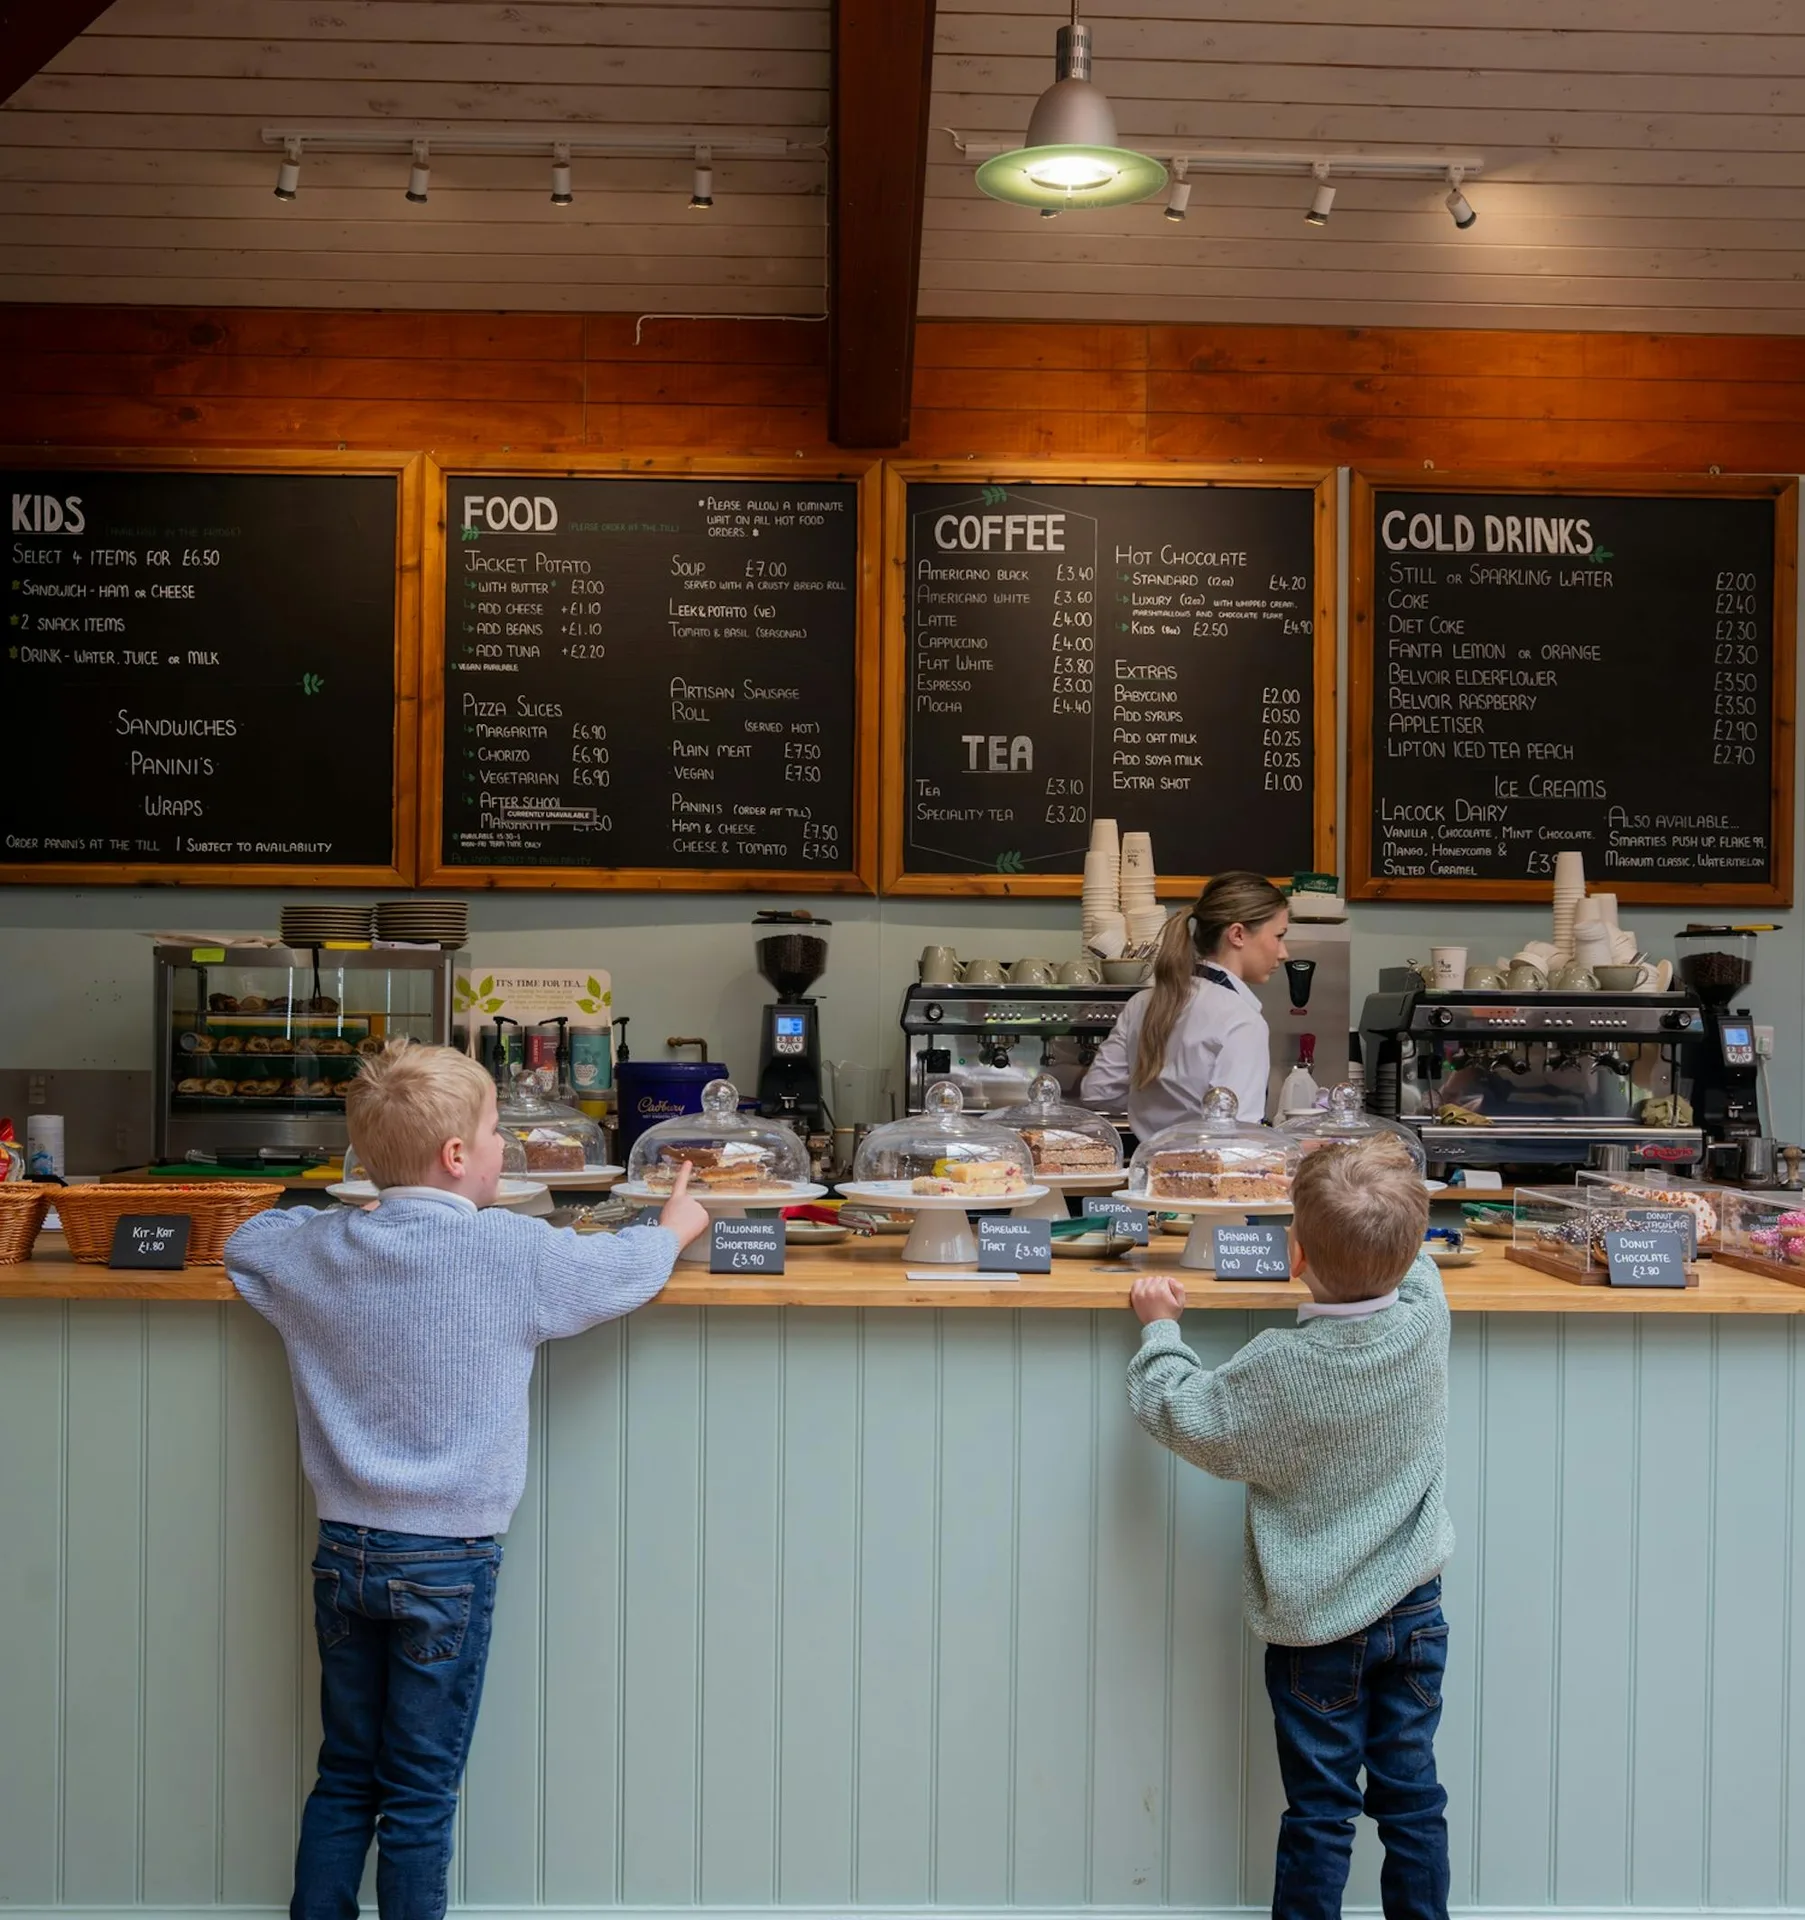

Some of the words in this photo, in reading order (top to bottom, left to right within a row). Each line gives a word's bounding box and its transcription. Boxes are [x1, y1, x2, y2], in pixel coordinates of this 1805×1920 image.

[12, 494, 85, 532] KIDS
[464, 496, 557, 531] FOOD
[707, 515, 730, 524] WAIT
[735, 515, 750, 525] ON
[754, 516, 770, 525] ALL
[775, 516, 795, 525] HOT
[799, 516, 824, 525] FOOD
[935, 514, 1065, 551] COFFEE
[1382, 510, 1474, 551] COLD
[1485, 515, 1593, 554] DRINKS
[13, 543, 62, 564] SELECT
[73, 551, 82, 564] 4
[91, 550, 137, 566] ITEMS
[147, 550, 170, 565] FOR
[183, 549, 219, 566] £6.50
[464, 550, 527, 573] JACKET
[536, 552, 591, 573] POTATO
[1116, 545, 1152, 564] HOT
[1161, 544, 1246, 566] CHOCOLATE
[671, 554, 705, 576] SOUP
[746, 559, 786, 577] £7.00
[919, 560, 990, 580] AMERICANO
[997, 570, 1029, 580] BLACK
[1057, 564, 1093, 581] £3.40
[1390, 562, 1436, 584] STILL
[1447, 574, 1462, 584] OR
[1470, 563, 1551, 585] SPARKLING
[1560, 571, 1613, 587] WATER
[479, 582, 506, 592] WITH
[511, 582, 548, 593] BUTTER
[572, 579, 604, 594] £7.00
[684, 580, 716, 589] SERVED
[719, 581, 741, 589] WITH
[746, 581, 754, 589] A
[758, 581, 789, 590] CRUSTY
[794, 582, 823, 590] BREAD
[827, 581, 845, 590] ROLL
[1388, 589, 1428, 609] COKE
[21, 614, 29, 629] 2
[37, 617, 80, 631] SNACK
[85, 618, 125, 632] ITEMS
[918, 610, 956, 626] LATTE
[1053, 611, 1092, 627] £4.00
[918, 632, 988, 649] CAPPUCCINO
[1053, 634, 1093, 651] £4.00
[919, 654, 950, 670] FLAT
[957, 655, 993, 670] WHITE
[1054, 656, 1093, 674] £3.80
[1115, 660, 1177, 679] EXTRAS
[918, 677, 971, 691] ESPRESSO
[1053, 677, 1092, 693] £3.00
[1389, 662, 1450, 685] BELVOIR
[1456, 670, 1557, 686] ELDERFLOWER
[1714, 672, 1756, 692] £3.50
[671, 677, 734, 698] ARTISAN
[744, 679, 799, 699] SAUSAGE
[1115, 684, 1177, 702] BABYCCINO
[1263, 688, 1300, 704] £2.00
[464, 693, 506, 716] PIZZA
[517, 695, 562, 717] SLICES
[918, 696, 962, 712] MOCHA
[1053, 697, 1091, 714] £4.40
[1389, 687, 1452, 709] BELVOIR
[1459, 694, 1536, 710] RASPBERRY
[1715, 694, 1756, 715] £3.50
[672, 701, 710, 721] ROLL
[1114, 706, 1141, 722] ADD
[1145, 711, 1183, 722] SYRUPS
[1262, 707, 1300, 723] £0.50
[117, 709, 236, 736] SANDWICHES
[476, 724, 547, 737] MARGARITA
[573, 723, 606, 740] £6.90
[1389, 713, 1484, 733] APPLETISER
[1114, 728, 1141, 743] ADD
[1146, 733, 1167, 743] OAT
[1170, 733, 1197, 744] MILK
[1263, 729, 1301, 746] £0.25
[478, 747, 530, 761] CHORIZO
[573, 746, 608, 763] £6.90
[673, 742, 708, 756] PLAIN
[717, 745, 752, 757] MEAT
[785, 742, 820, 759] £7.50
[962, 735, 1033, 770] TEA
[1388, 738, 1445, 757] LIPTON
[1453, 741, 1485, 758] ICED
[1488, 742, 1520, 758] TEA
[1527, 743, 1573, 760] PEACH
[1113, 751, 1140, 765] ADD
[1145, 755, 1171, 765] SOYA
[1175, 755, 1203, 765] MILK
[1264, 750, 1300, 767] £0.25
[480, 770, 559, 785] VEGETARIAN
[573, 769, 609, 787] £6.90
[674, 767, 714, 780] VEGAN
[785, 766, 820, 782] £7.50
[1113, 771, 1154, 789] EXTRA
[1161, 777, 1190, 789] SHOT
[1265, 772, 1302, 791] £1.00
[916, 779, 940, 796] TEA
[1046, 778, 1083, 795] £3.10
[1495, 776, 1520, 799] ICE
[1529, 775, 1606, 799] CREAMS
[145, 796, 202, 816] WRAPS
[917, 804, 983, 820] SPECIALITY
[988, 809, 1013, 821] TEA
[1045, 805, 1086, 823] £3.20
[1382, 798, 1445, 821] LACOCK
[1456, 799, 1507, 822] DAIRY
[672, 819, 700, 833] HAM
[705, 824, 712, 834] &
[718, 824, 755, 834] CHEESE
[803, 821, 838, 840] £7.50
[6, 835, 38, 848] ORDER
[90, 839, 103, 849] AT
[109, 839, 129, 850] THE
[135, 840, 159, 851] TILL
[187, 838, 232, 852] SUBJECT
[237, 842, 252, 851] TO
[256, 843, 332, 852] AVAILABILITY
[638, 1097, 686, 1113] Cadbury
[1089, 1202, 1132, 1213] FLAPJACK
[715, 1221, 774, 1234] MILLIONAIRE
[982, 1222, 1030, 1234] BAKEWELL
[1116, 1221, 1142, 1233] £3.80
[1218, 1230, 1259, 1242] BANANA
[1266, 1233, 1272, 1242] &
[138, 1242, 164, 1254] £1.80
[716, 1237, 776, 1250] SHORTBREAD
[981, 1239, 1006, 1251] TART
[1015, 1243, 1046, 1259] £3.90
[1220, 1245, 1270, 1255] BLUEBERRY
[1620, 1238, 1657, 1249] DONUT
[732, 1253, 764, 1267] £3.90
[1222, 1259, 1240, 1269] (VE)
[1256, 1259, 1284, 1274] £4.30
[1615, 1253, 1670, 1263] CHOCOLATE
[1633, 1265, 1659, 1278] £2.80
